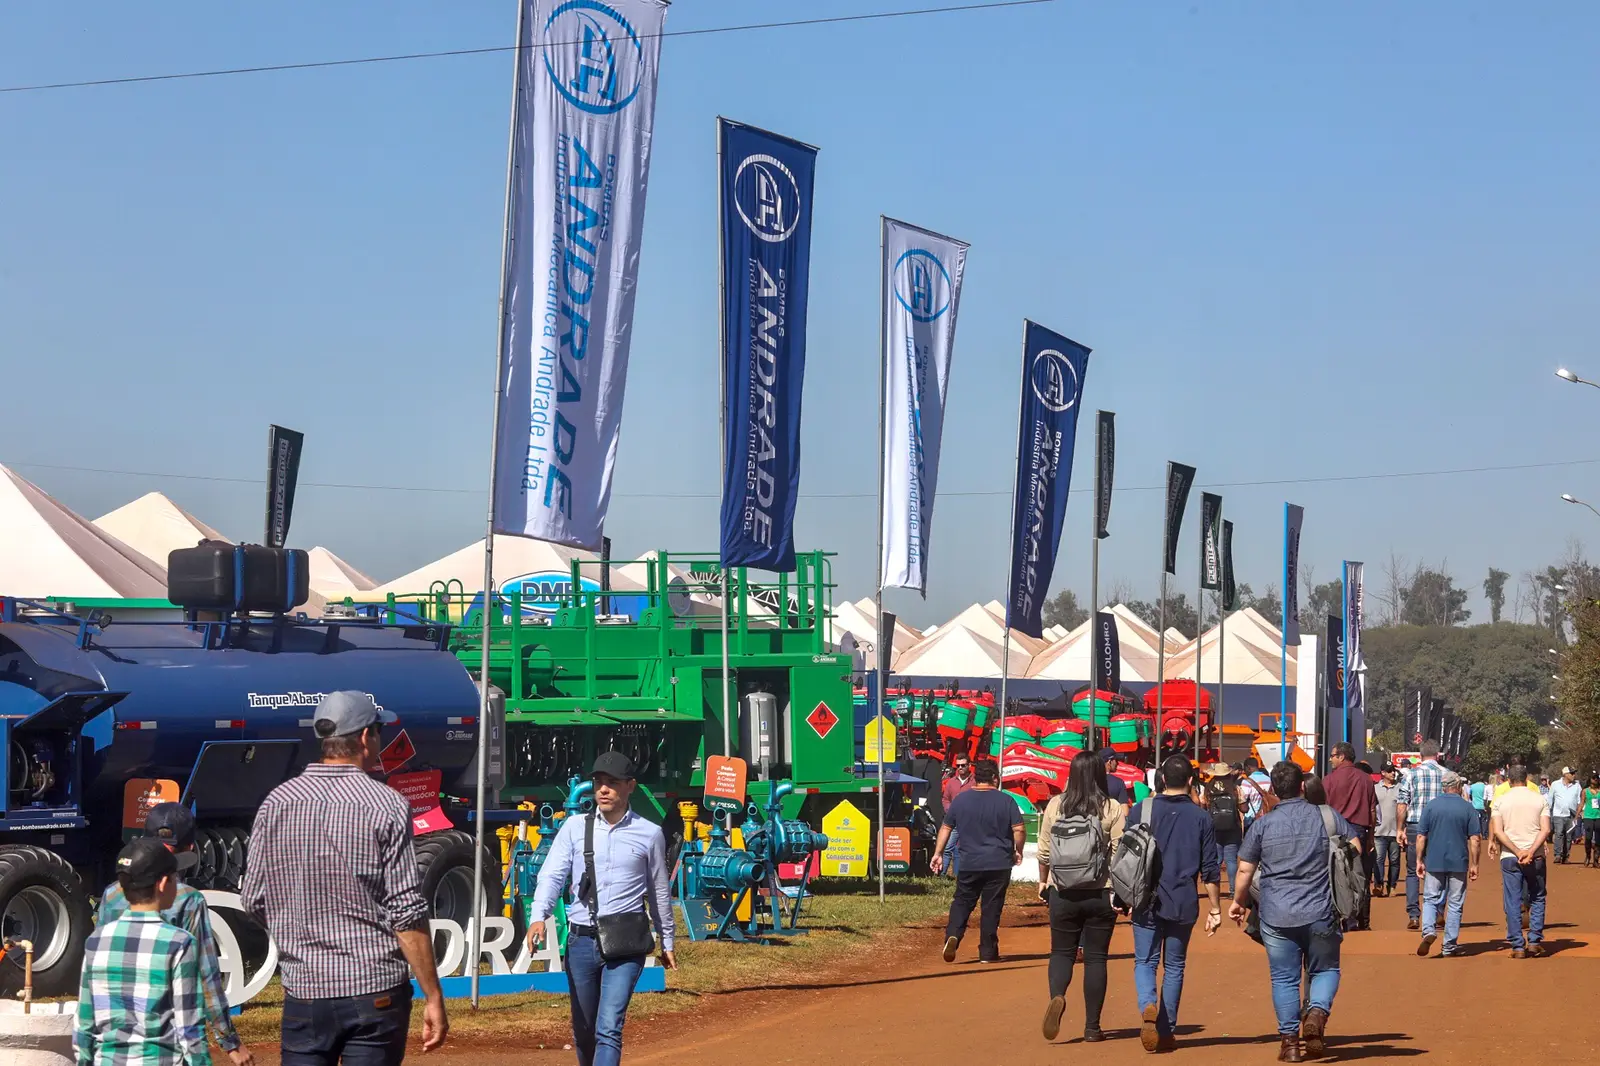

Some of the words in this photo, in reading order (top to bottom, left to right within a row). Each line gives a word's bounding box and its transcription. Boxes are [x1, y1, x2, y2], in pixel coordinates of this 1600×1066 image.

[600, 153, 616, 242] BOMBAS
[543, 135, 603, 520] ANDRADE
[778, 268, 786, 337] BOMBAS
[528, 345, 557, 436] Andrade
[753, 258, 778, 550] ANDRADE
[519, 444, 547, 495] Ltda.
[746, 420, 758, 490] Andrade
[1049, 431, 1063, 478] BOMBAS
[743, 495, 755, 535] Ltda.
[908, 472, 920, 530] Andrade
[1022, 421, 1053, 623] ANDRADE
[1103, 621, 1112, 677] COLOMBO
[249, 692, 290, 708] Tanque
